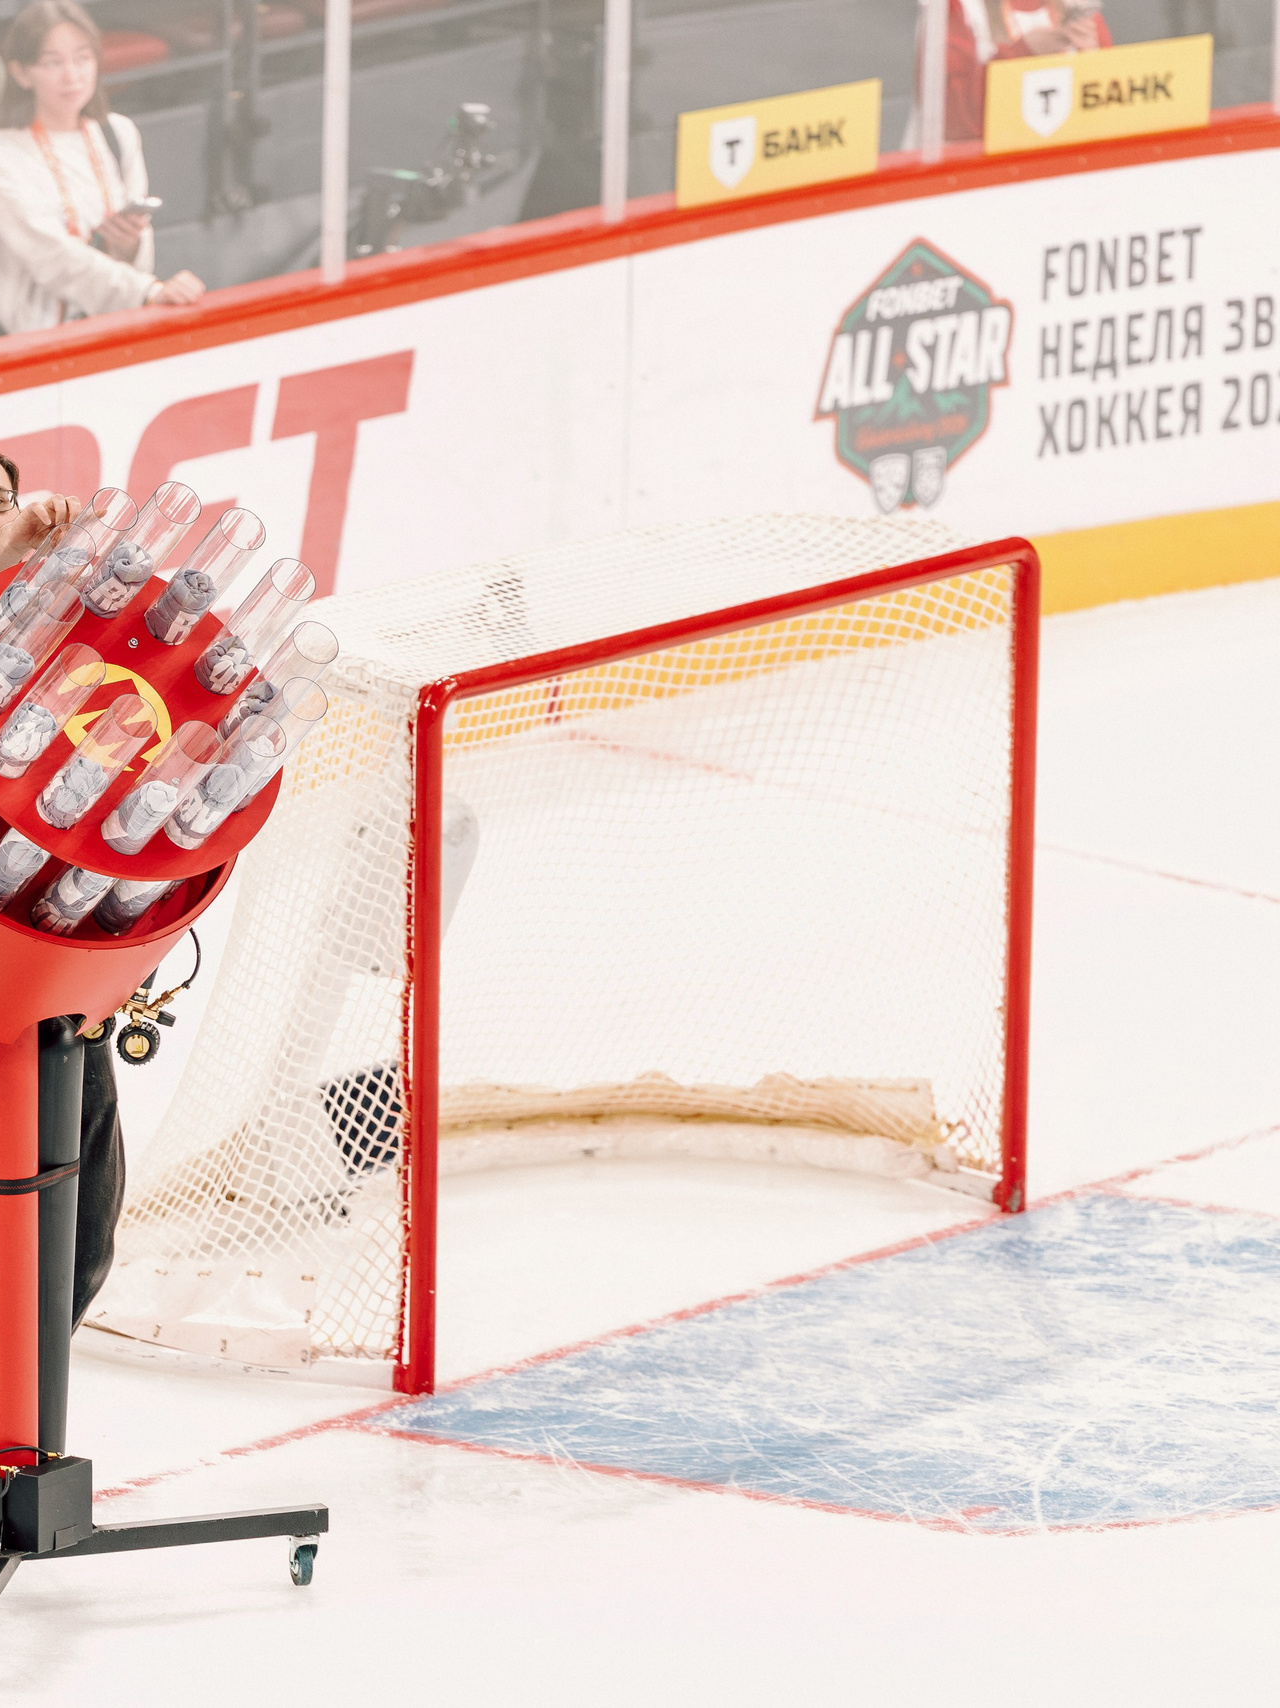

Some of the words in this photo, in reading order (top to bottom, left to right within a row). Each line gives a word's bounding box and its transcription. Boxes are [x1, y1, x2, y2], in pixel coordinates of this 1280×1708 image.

[1080, 72, 1175, 111] БАНК
[762, 119, 848, 162] БАНК
[865, 275, 965, 323] FONBET
[1041, 226, 1204, 302] FONBET
[818, 325, 896, 413] ALL
[904, 305, 1012, 394] STAR
[1039, 304, 1204, 383] НЕДЕЛЯ
[1036, 381, 1203, 459] ХОККЕЯ
[1220, 372, 1280, 430] 20
